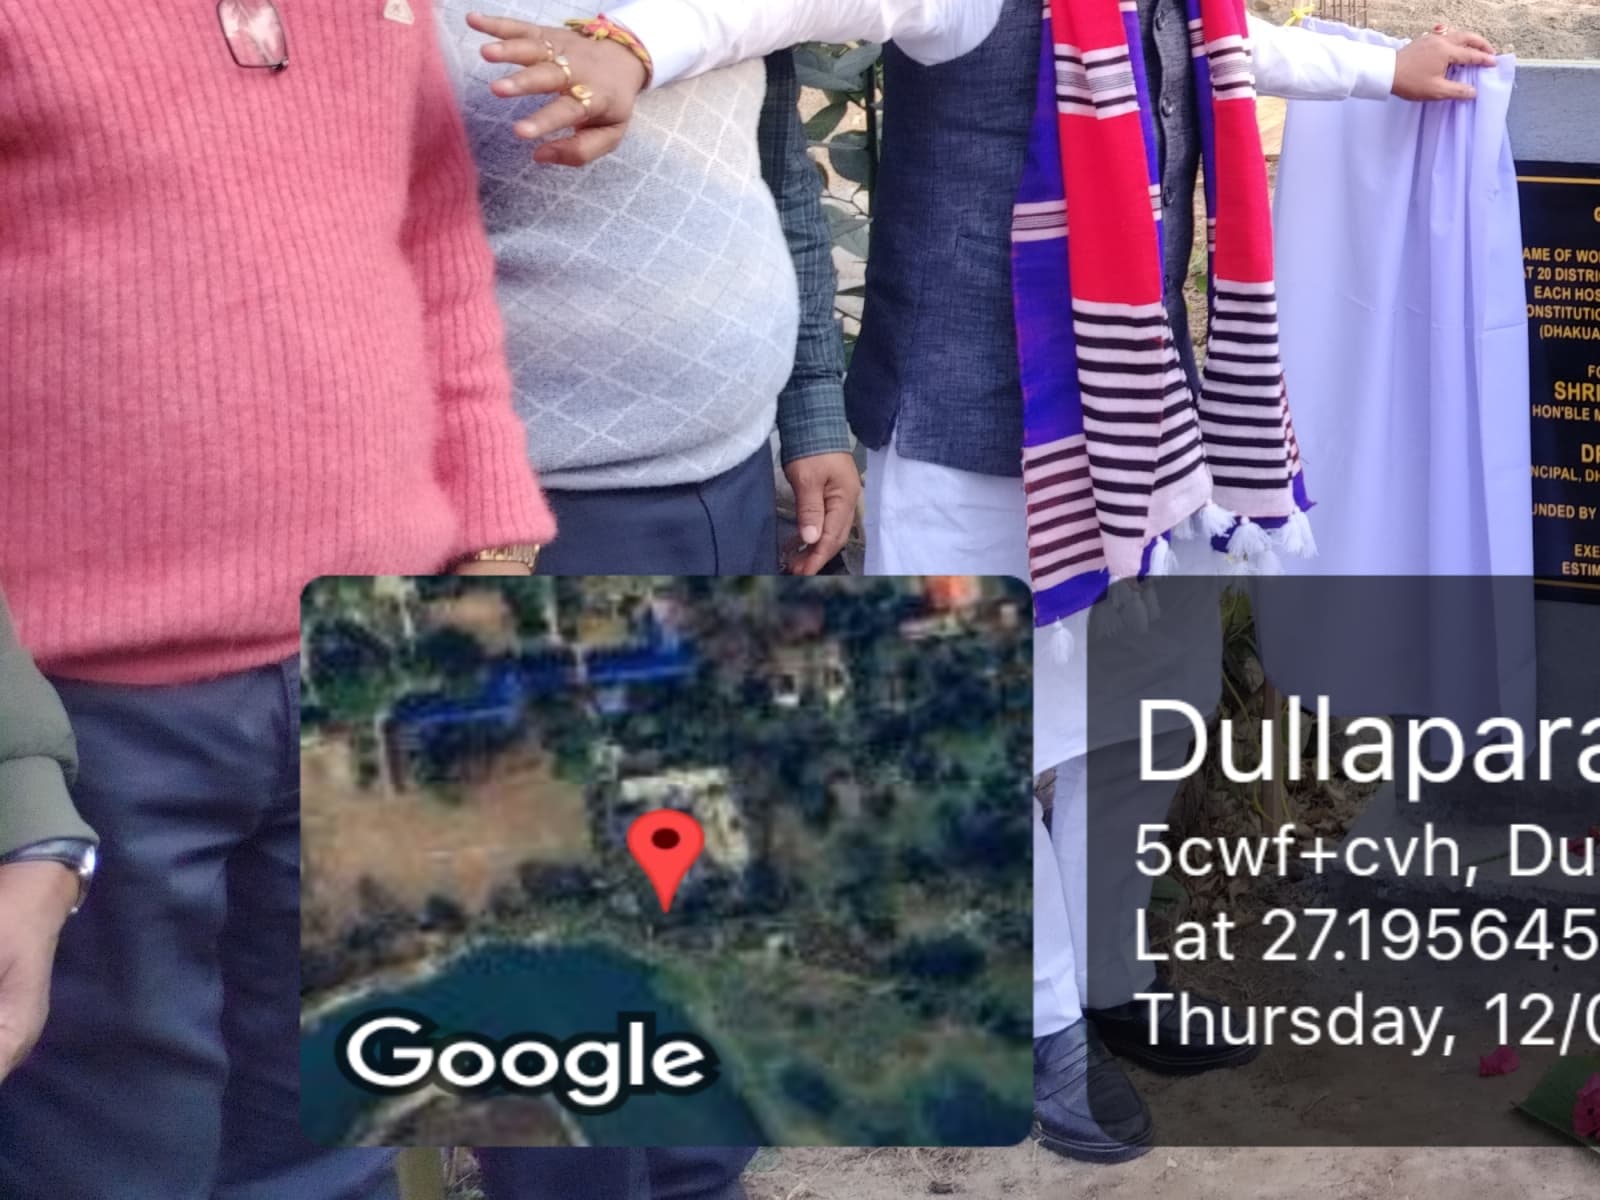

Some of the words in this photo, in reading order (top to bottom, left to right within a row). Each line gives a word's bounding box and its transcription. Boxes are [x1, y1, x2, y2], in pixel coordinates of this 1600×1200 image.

[1554, 248, 1573, 262] OF
[1537, 267, 1552, 280] 20
[1534, 285, 1571, 300] EACH
[1554, 381, 1600, 403] SHRI
[1532, 404, 1590, 421] HON'BLE
[1579, 506, 1596, 520] BY
